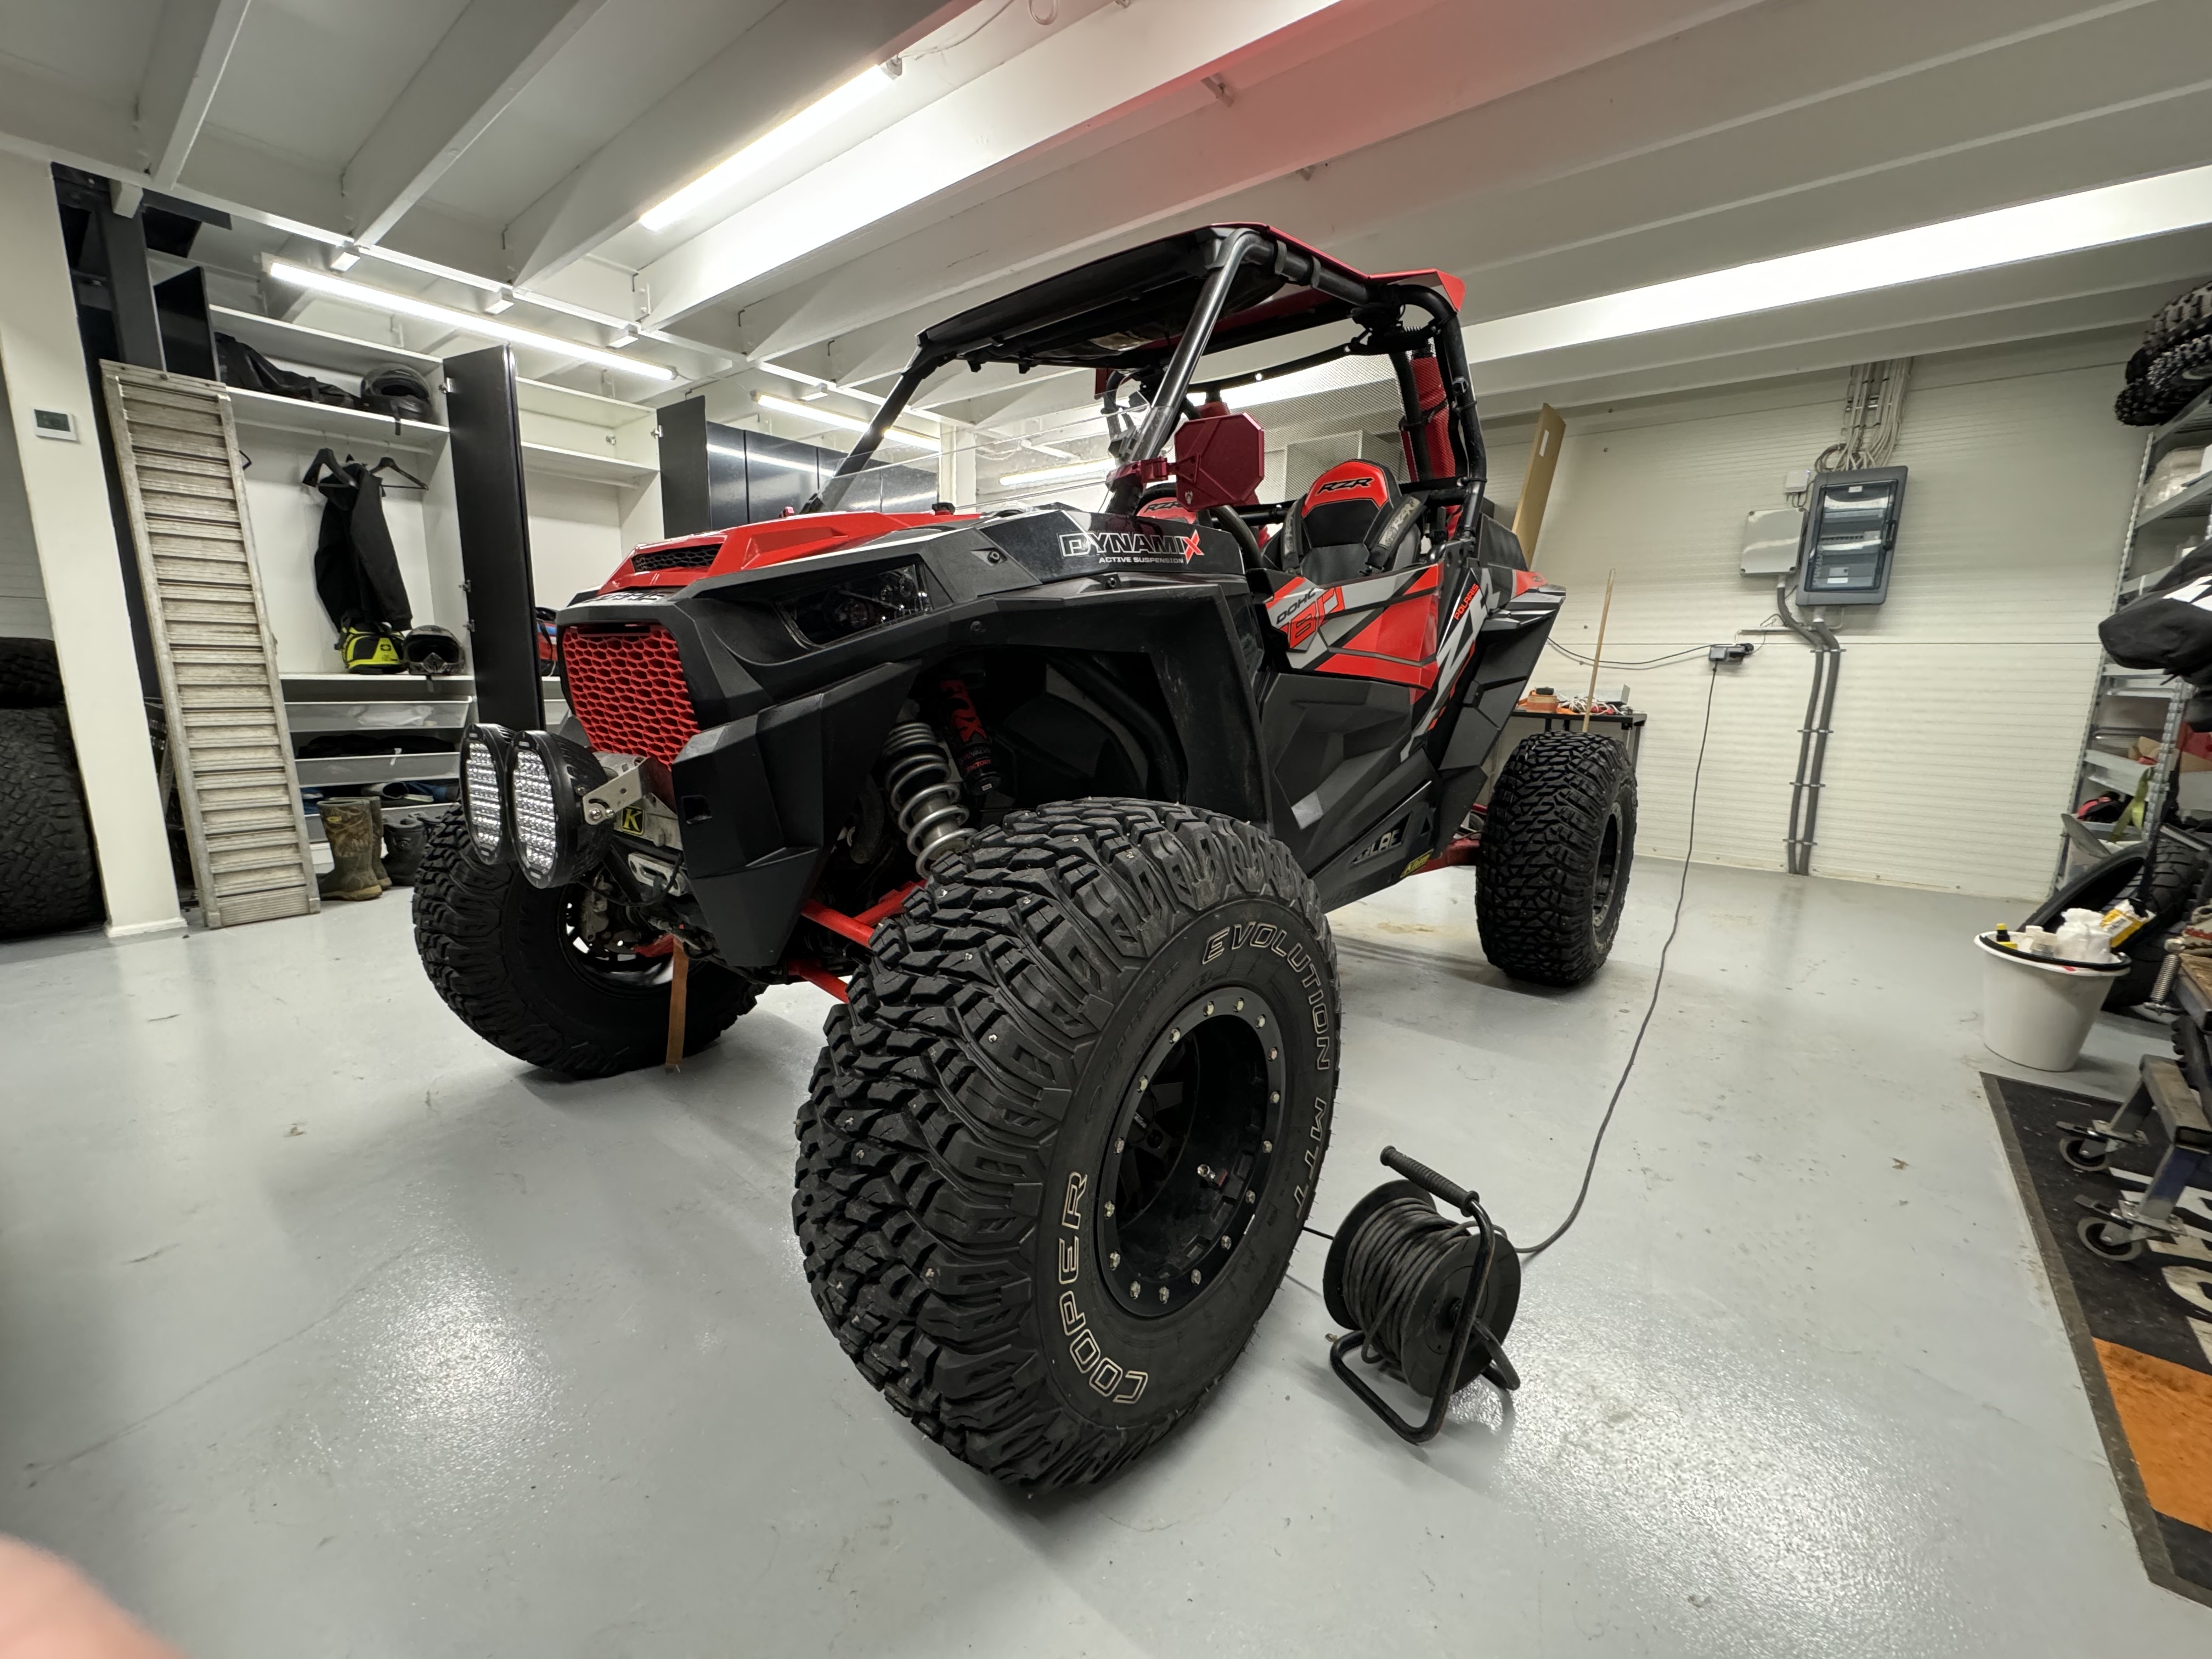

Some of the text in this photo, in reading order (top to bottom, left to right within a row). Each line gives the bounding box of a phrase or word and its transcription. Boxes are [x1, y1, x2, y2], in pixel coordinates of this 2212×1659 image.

[1316, 477, 1374, 495] RZR
[1058, 529, 1205, 565] DYNAMIX
[1276, 587, 1316, 625] DOHC
[1454, 583, 1480, 620] POLARIS
[622, 808, 642, 831] K
[1202, 921, 1330, 1070] EVOLUTION
[1058, 1171, 1148, 1404] COOPER
